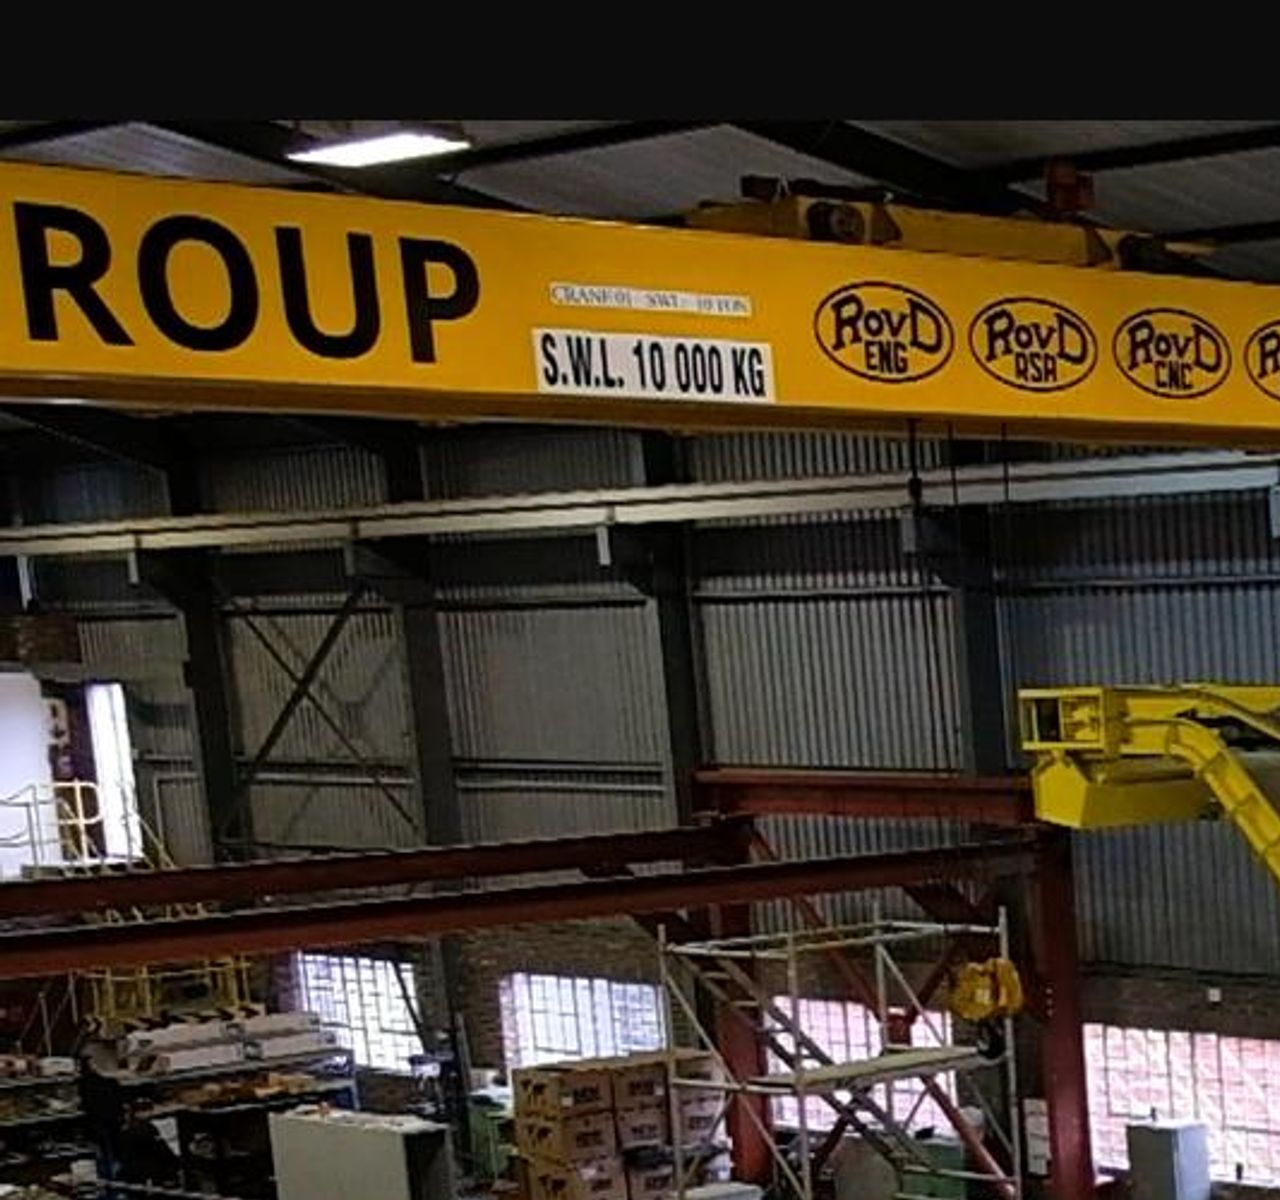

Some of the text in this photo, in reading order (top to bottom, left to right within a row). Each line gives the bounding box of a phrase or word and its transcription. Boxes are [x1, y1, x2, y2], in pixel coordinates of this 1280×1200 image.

[540, 333, 766, 397] S.W.L. 10 000 KG
[864, 340, 909, 375] ENG
[1153, 359, 1194, 390] CNC
